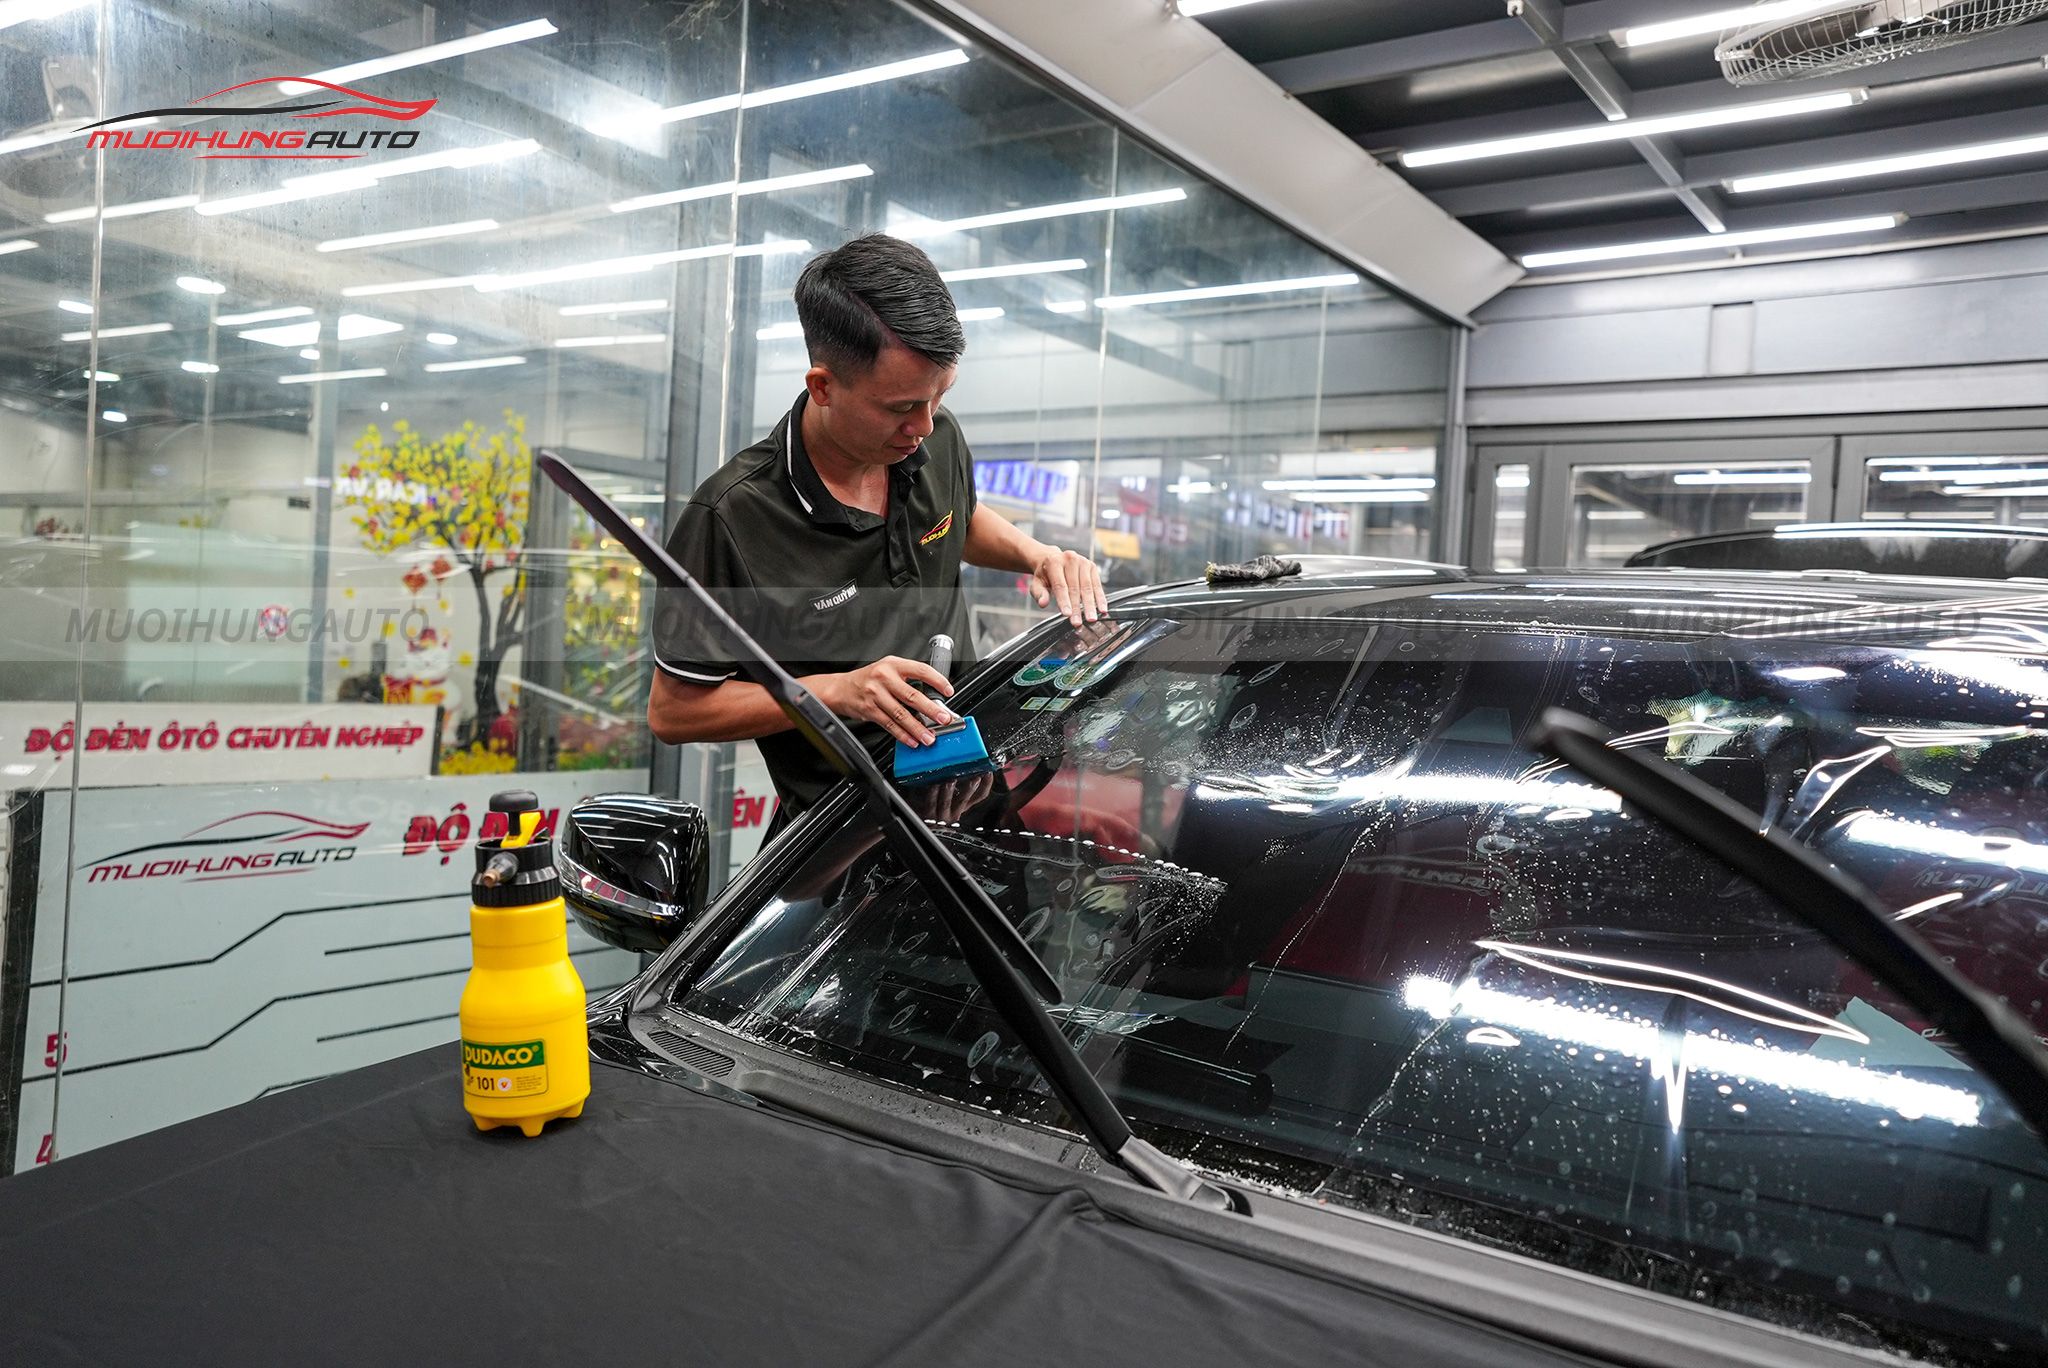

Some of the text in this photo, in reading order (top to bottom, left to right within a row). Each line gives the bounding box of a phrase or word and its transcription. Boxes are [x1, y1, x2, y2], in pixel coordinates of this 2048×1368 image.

[158, 720, 219, 751] ÔTÔ
[227, 720, 331, 749] CHUYÊN
[335, 719, 424, 754] NGHIỆP
[402, 802, 471, 866] ĐỘ
[464, 1045, 534, 1065] DUDACO
[476, 1076, 495, 1091] 101
